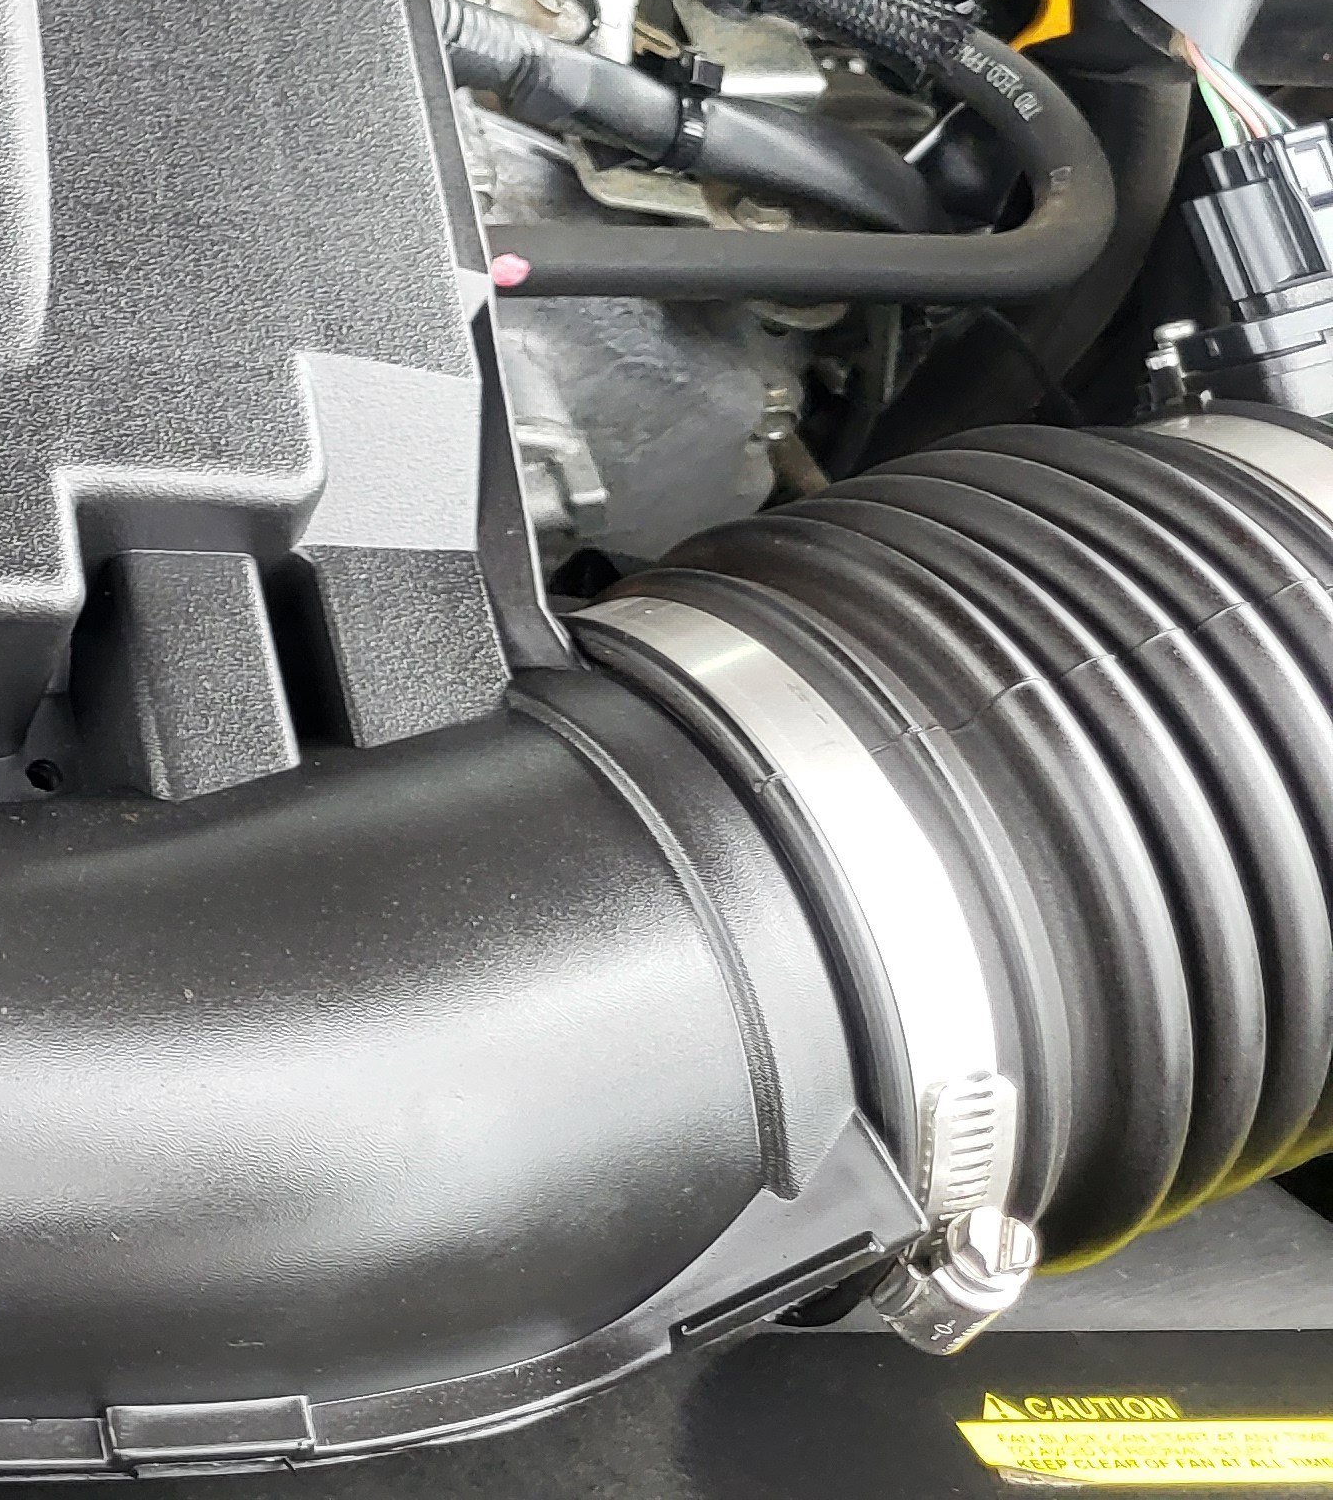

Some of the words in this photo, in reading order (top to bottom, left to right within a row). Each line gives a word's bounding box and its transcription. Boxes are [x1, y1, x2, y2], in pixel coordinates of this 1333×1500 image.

[1023, 1396, 1181, 1420] CAUTION
[1016, 1459, 1067, 1470] KEEP
[1074, 1459, 1140, 1469] CLEAR
[1145, 1459, 1169, 1469] OF
[1175, 1459, 1216, 1468] FAN
[1220, 1458, 1240, 1468] AT
[1249, 1458, 1284, 1468] ALL
